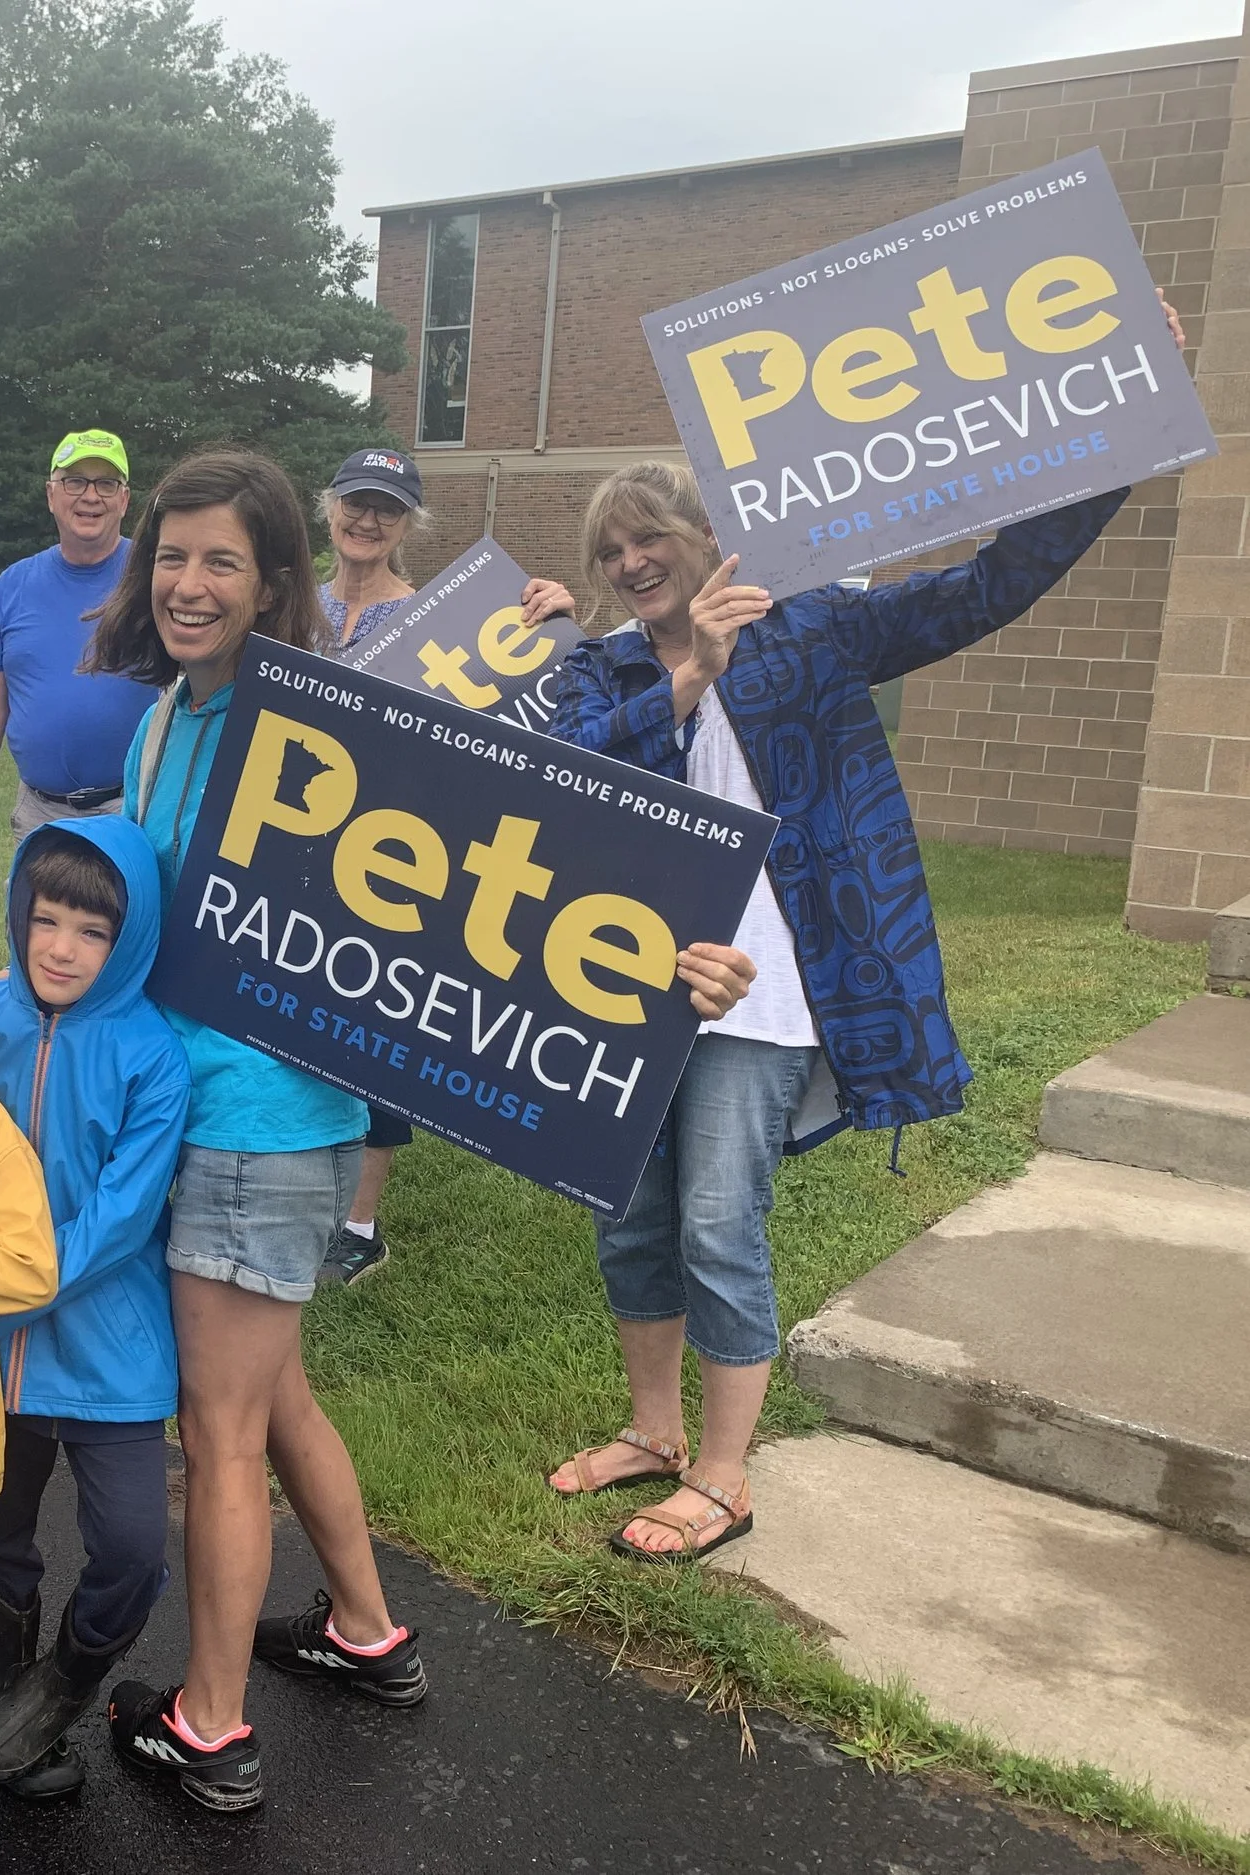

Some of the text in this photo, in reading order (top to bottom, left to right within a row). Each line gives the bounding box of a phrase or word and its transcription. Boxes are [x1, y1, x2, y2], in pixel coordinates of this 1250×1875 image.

[663, 291, 764, 338] SOLUTIONS
[781, 270, 819, 294] NOT
[824, 237, 916, 278] SLOGANS-
[921, 211, 980, 242] SOLVE
[985, 170, 1088, 218] PROBLEMS
[686, 255, 1121, 470] Pete
[730, 344, 1160, 532] RADOSEVICH
[808, 510, 873, 547] FOR
[883, 474, 982, 522] STATE
[992, 430, 1110, 486] HOUSE
[405, 598, 438, 628] SOLVE
[438, 552, 492, 600] PROBLEMS
[417, 606, 556, 709] te
[258, 660, 364, 712] SOLUTIONS
[384, 706, 427, 734] NOT
[430, 724, 536, 771] SLOGANS-
[542, 764, 613, 802] SOLVE
[618, 791, 744, 849] PROBLEMS
[218, 708, 676, 1025] Pete
[194, 874, 644, 1118] RADOSEVICH
[236, 971, 544, 1131] FOR STATE HOUSE
[246, 1034, 272, 1050] PREPARED
[277, 1050, 289, 1058] PAID
[290, 1056, 300, 1064] FOR
[301, 1060, 308, 1068] BY
[308, 1064, 322, 1074] PETE
[322, 1070, 355, 1090] RADOSEVICH
[356, 1086, 367, 1096] FOR
[422, 1117, 433, 1126] BOX
[464, 1137, 474, 1146] MN
